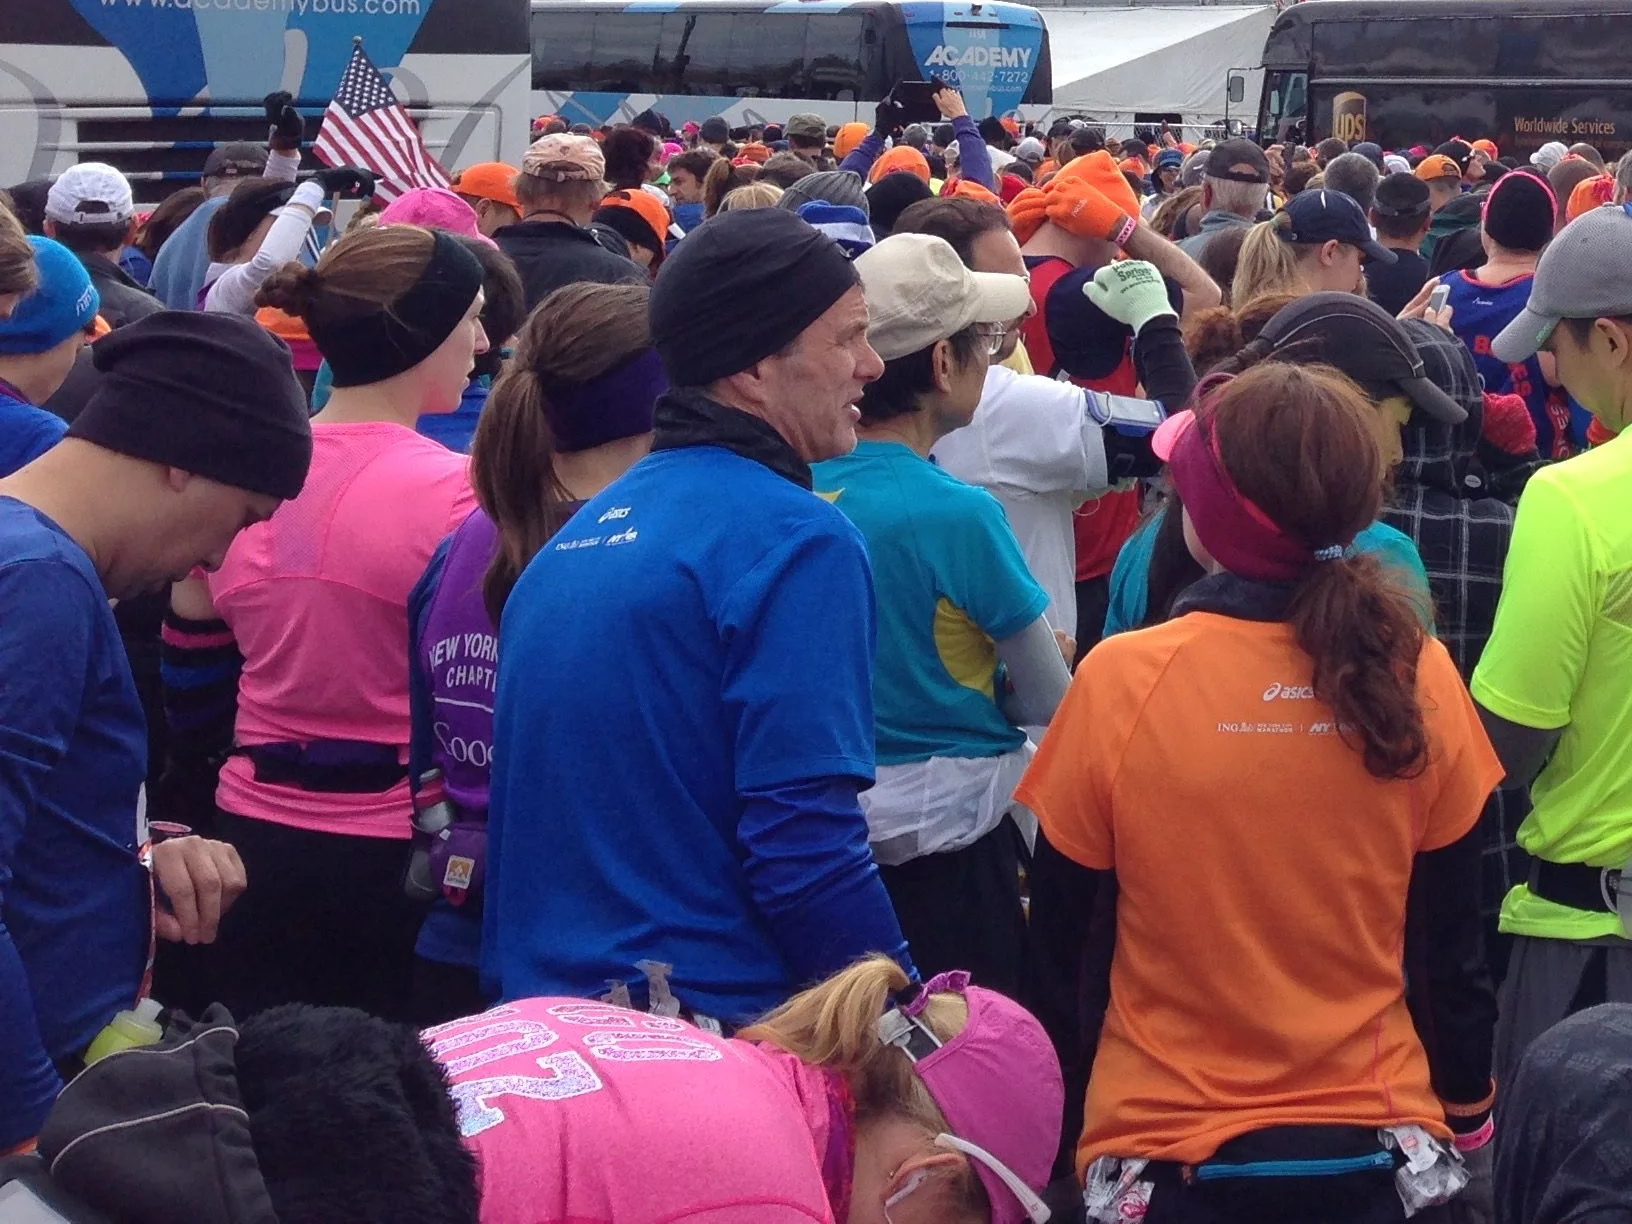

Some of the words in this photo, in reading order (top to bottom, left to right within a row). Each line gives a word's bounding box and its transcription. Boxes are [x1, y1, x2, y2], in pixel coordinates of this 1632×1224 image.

[924, 45, 1032, 68] ACADEMY
[1514, 116, 1568, 134] Worldwide
[1571, 117, 1616, 135] Services
